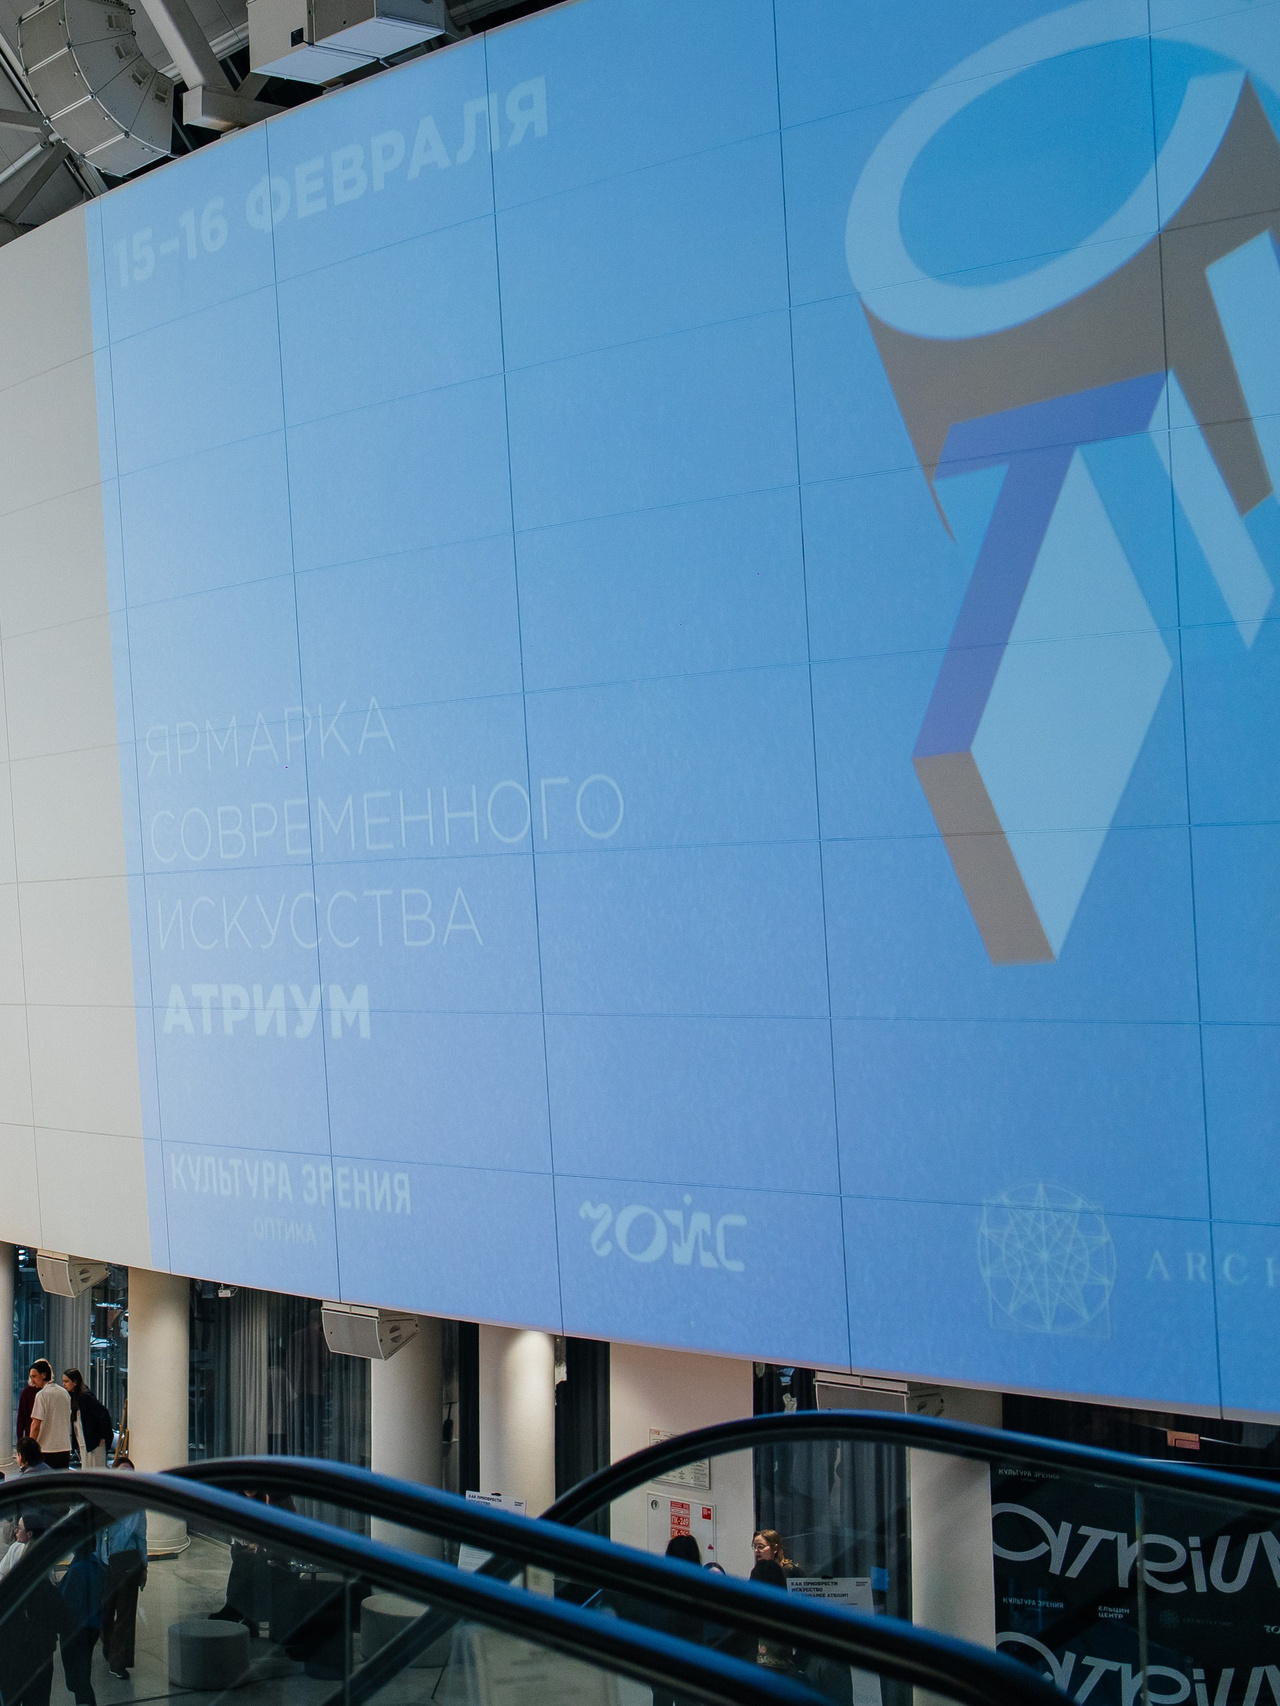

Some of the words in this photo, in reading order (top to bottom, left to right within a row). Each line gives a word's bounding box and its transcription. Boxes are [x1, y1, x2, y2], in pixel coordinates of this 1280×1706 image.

[245, 75, 550, 236] ФЕВРАЛЯ
[145, 696, 397, 777] ЯРМАРКА
[150, 774, 625, 864] СОВРЕМЕННОГО
[156, 886, 484, 951] ИСКУССТВА
[162, 983, 372, 1040] АТРИУМ
[170, 1152, 293, 1205] КУЛЬТУРА
[301, 1163, 412, 1215] ЗРЕНИЯ
[1098, 1606, 1130, 1614] ЕЛЬЦИН
